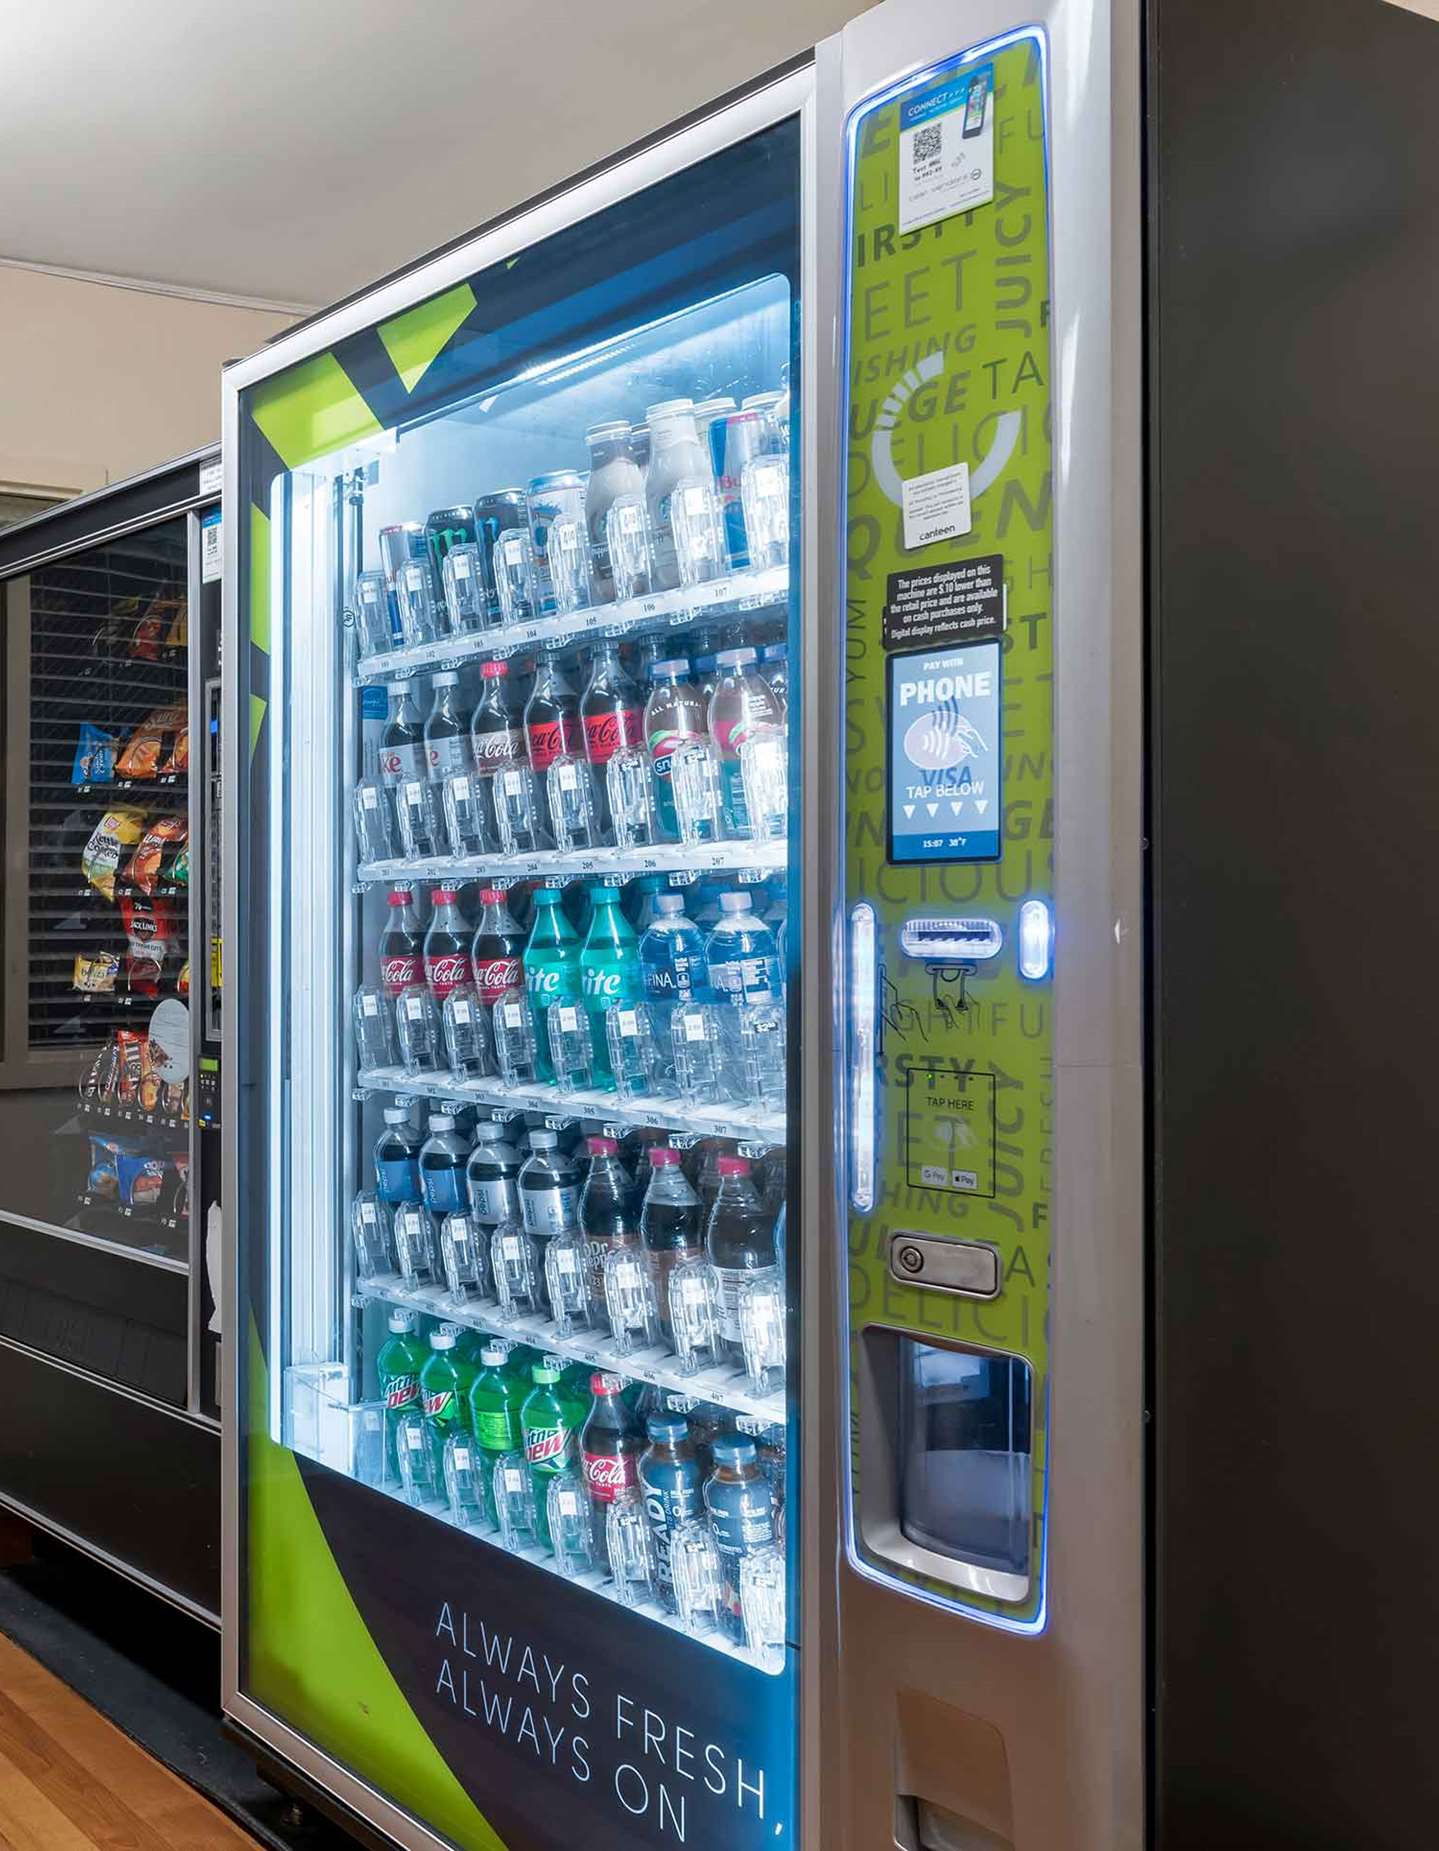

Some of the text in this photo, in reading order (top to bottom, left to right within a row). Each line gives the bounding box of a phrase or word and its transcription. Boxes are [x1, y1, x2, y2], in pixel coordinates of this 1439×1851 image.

[919, 524, 956, 541] canteen
[898, 564, 991, 592] The prices displayed on this
[890, 587, 998, 614] the retail price and are available
[896, 589, 925, 601] machine
[926, 587, 938, 597] are
[955, 581, 974, 592] lower
[975, 578, 992, 588] than
[903, 615, 912, 624] on
[913, 609, 929, 622] cash
[930, 606, 966, 621] purchases
[891, 627, 911, 640] Digital
[911, 625, 934, 637] display
[934, 621, 959, 633] reflects
[960, 618, 976, 629] cash
[923, 657, 964, 671] PAY WITH
[900, 671, 992, 706] PHONE
[920, 765, 973, 788] VISA
[906, 781, 985, 801] TAP BELOW
[926, 1096, 975, 1111] TAP HERE
[961, 1174, 975, 1185] Pay
[435, 1601, 783, 1836] ALWAYS FRESH,
[435, 1658, 686, 1844] ALWAYS ON
